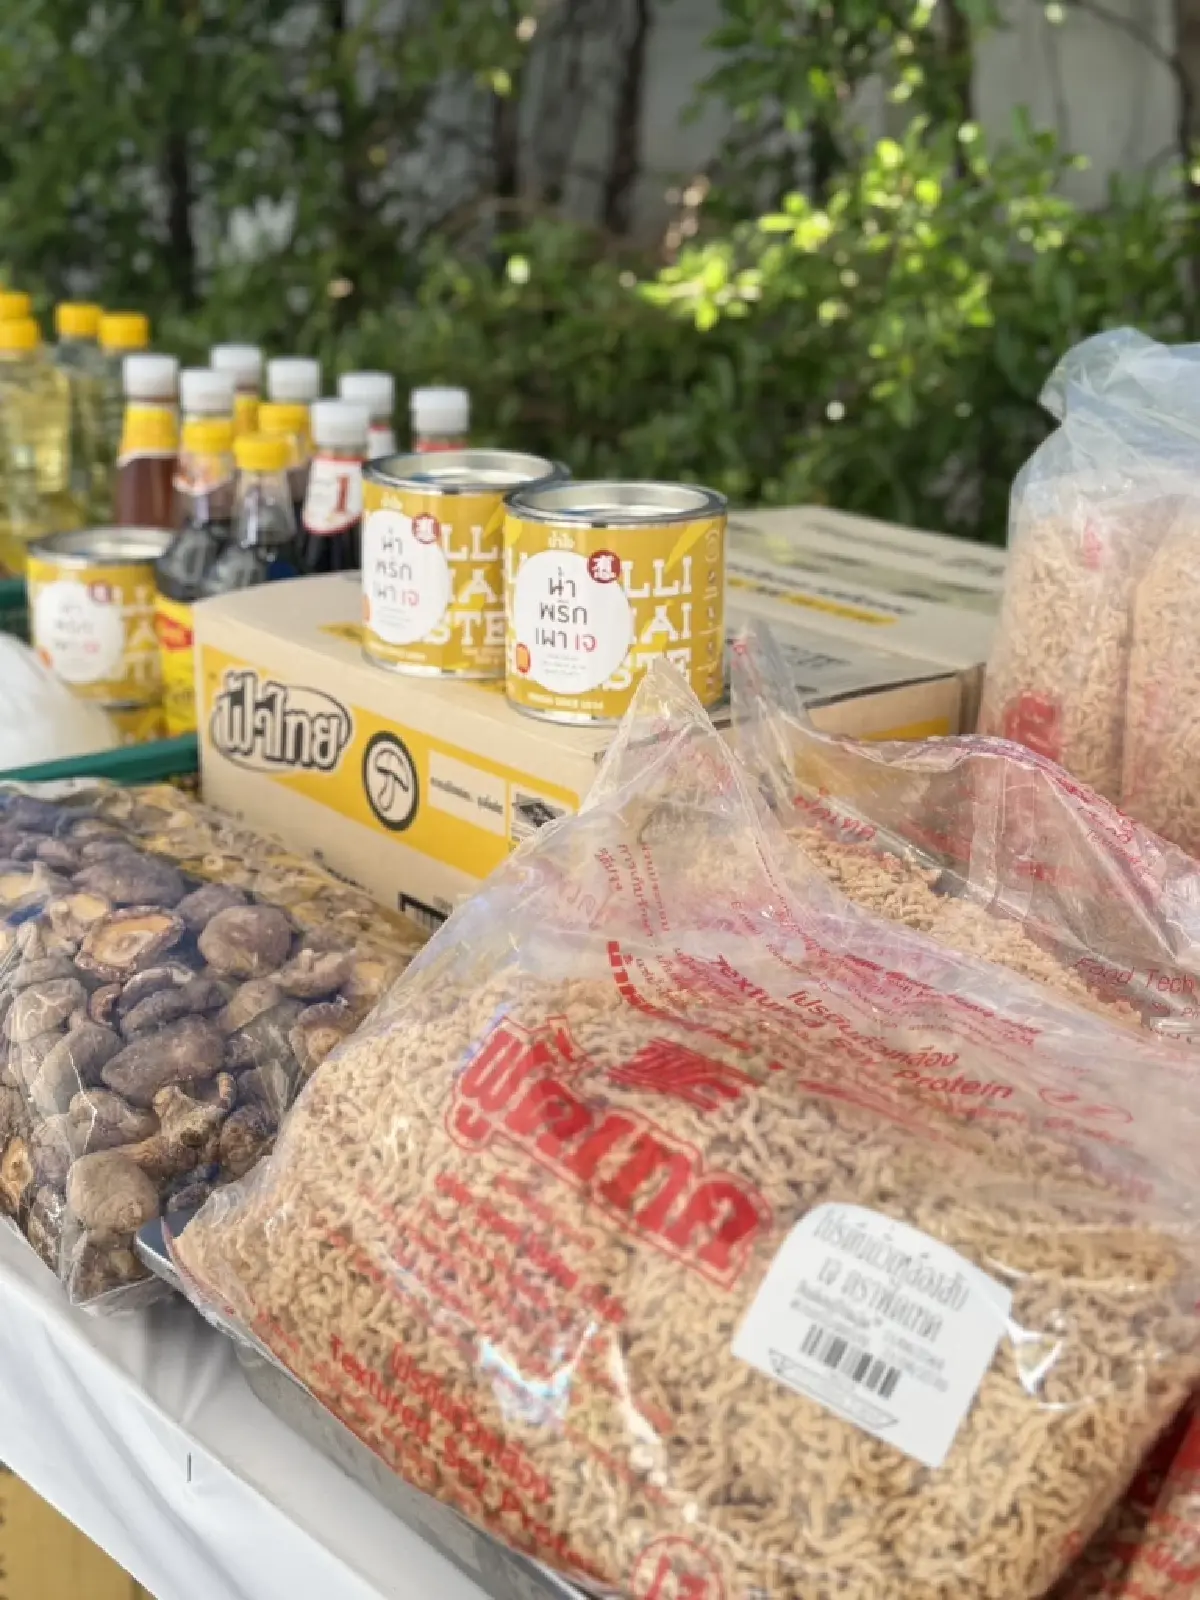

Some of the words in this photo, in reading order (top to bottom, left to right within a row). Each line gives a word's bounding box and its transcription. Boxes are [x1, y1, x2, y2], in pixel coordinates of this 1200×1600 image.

[547, 565, 577, 598] น้ำ
[539, 598, 588, 626] พริก
[535, 627, 568, 649] เผา
[574, 633, 598, 653] เจ
[212, 670, 345, 771] ฟ้าไทย
[893, 1069, 1014, 1099] Protein
